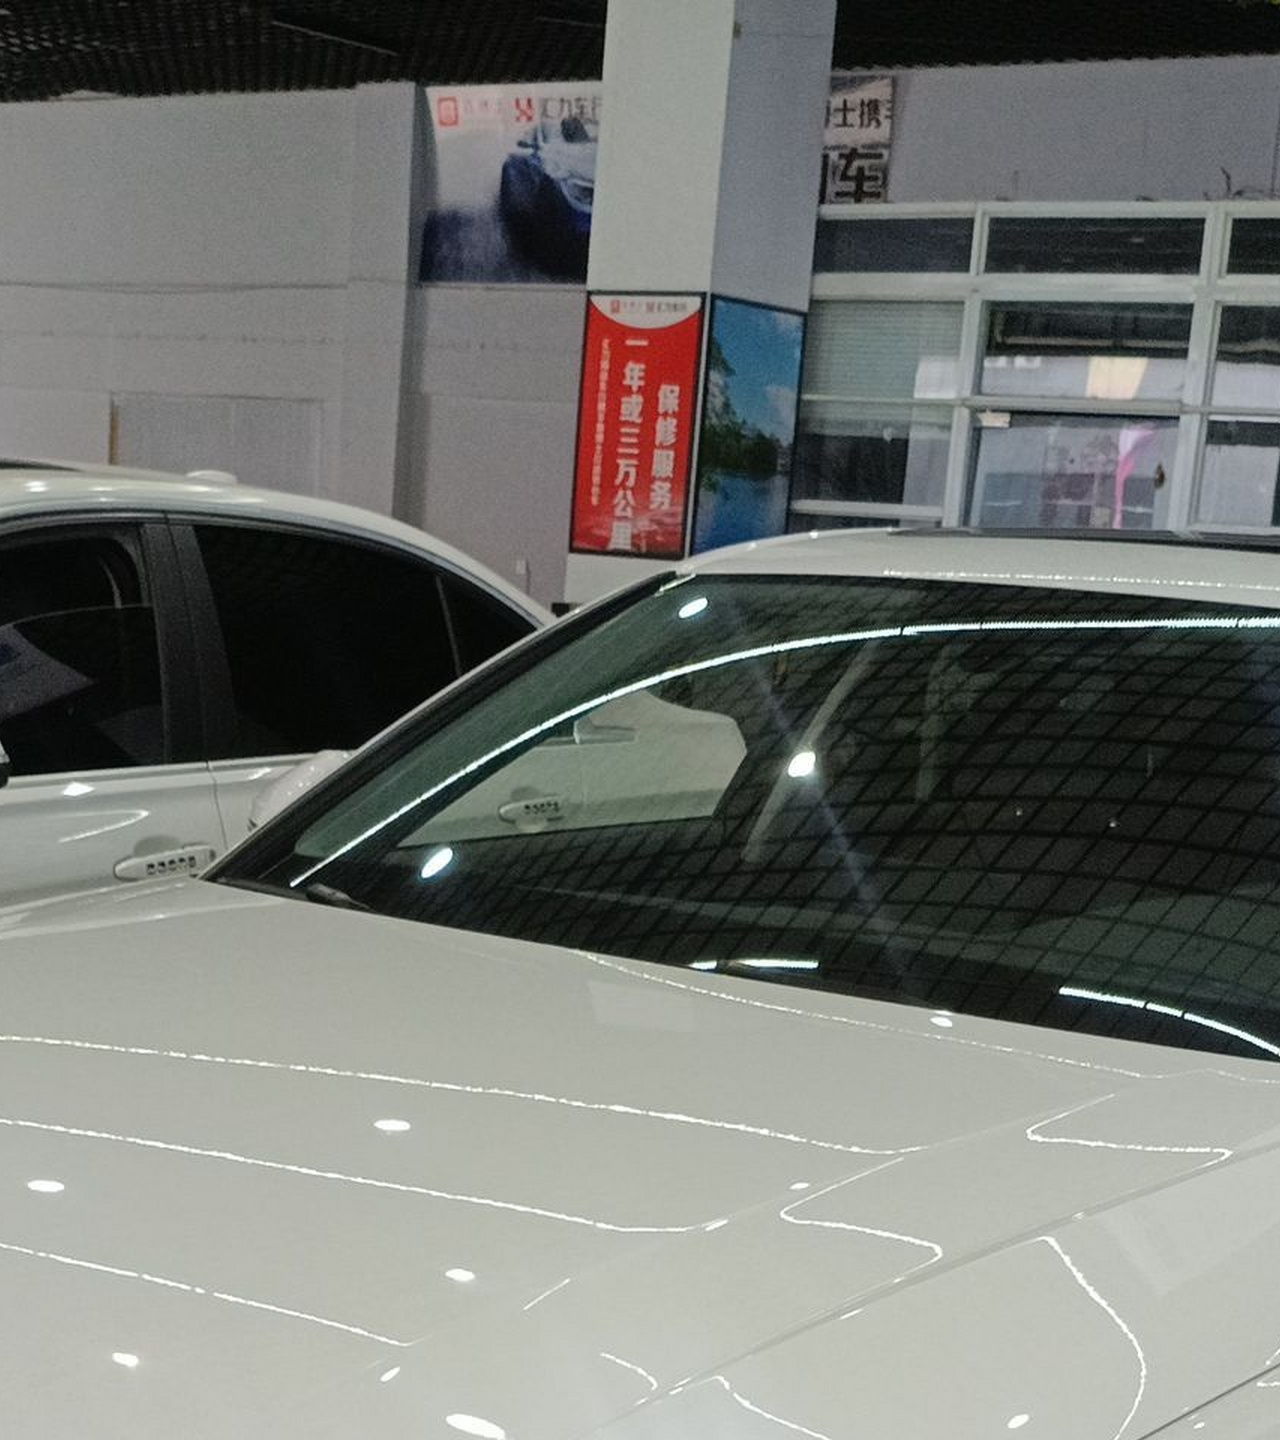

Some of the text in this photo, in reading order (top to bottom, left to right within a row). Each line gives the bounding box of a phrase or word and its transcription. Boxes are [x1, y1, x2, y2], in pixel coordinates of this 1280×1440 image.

[824, 98, 892, 129] 士携
[819, 147, 884, 204] 车
[606, 338, 649, 551] 一年或三万公里
[649, 384, 680, 511] 保修服务
